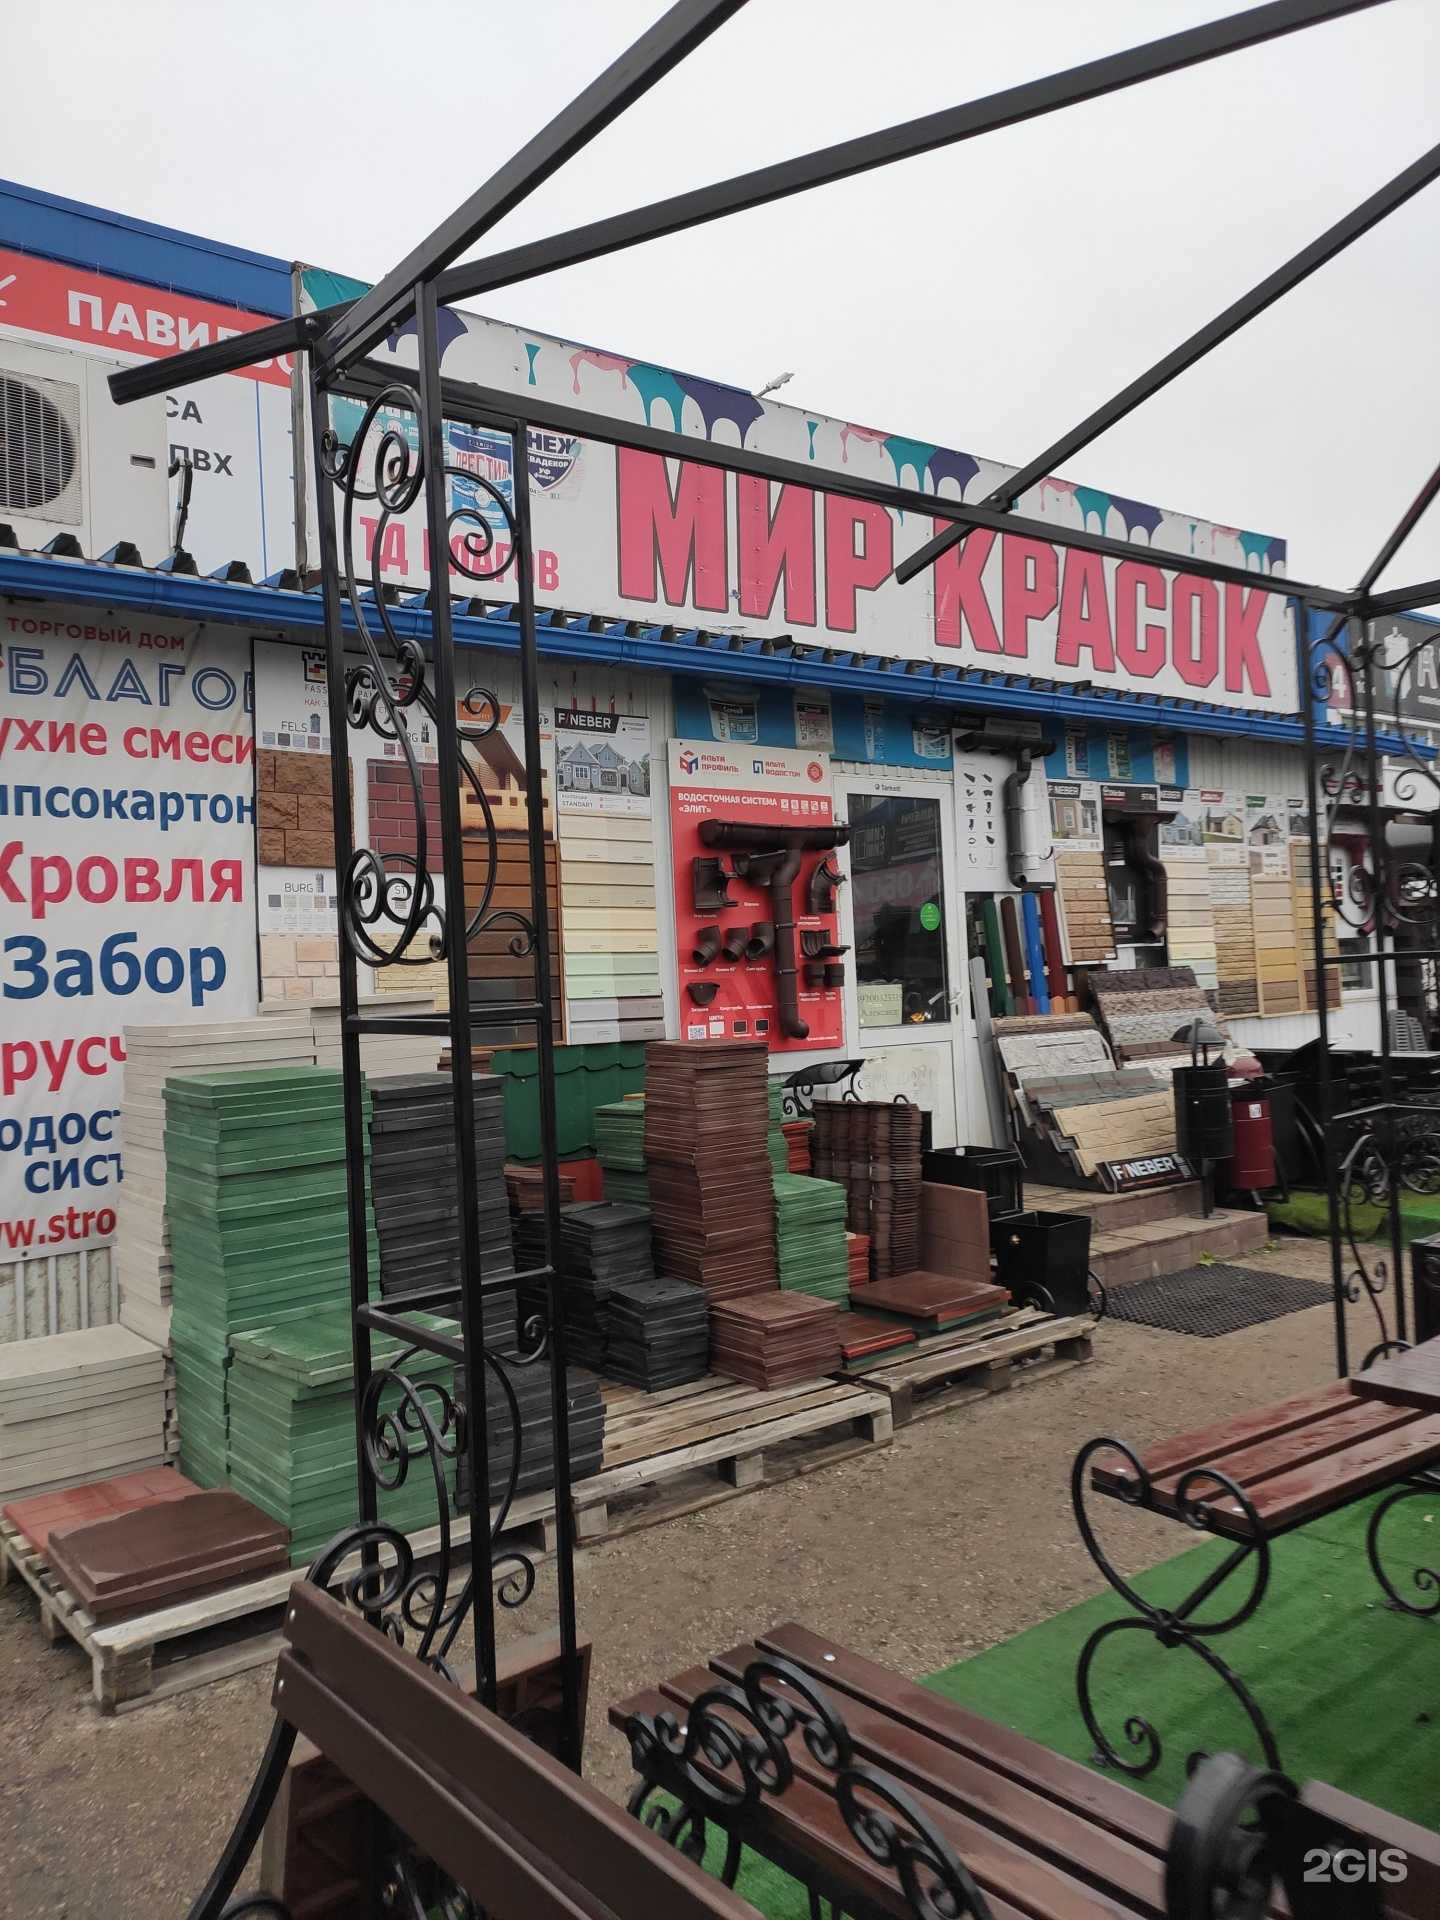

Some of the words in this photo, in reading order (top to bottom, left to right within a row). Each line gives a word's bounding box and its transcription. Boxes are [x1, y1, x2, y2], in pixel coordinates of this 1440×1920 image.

[67, 289, 295, 376] ПАВИ
[527, 454, 570, 468] ВАДЕКОР
[359, 516, 408, 576] ТД
[422, 528, 559, 591] ЛАГВ
[615, 444, 894, 634] МИР
[932, 516, 1272, 698] КРАСОК
[7, 616, 131, 645] ТОРГОВЫЙ
[138, 632, 185, 650] ДОМ
[123, 726, 254, 765] смеси
[281, 721, 308, 733] FELS
[701, 763, 740, 774] ПРОФИЛЬ
[678, 792, 741, 804] ВОДОСТОЧНАЯ
[742, 796, 778, 807] СИСТЕМА
[0, 841, 243, 919] Кровля
[284, 882, 314, 893] BURG
[3, 931, 227, 1007] Забор
[0, 1109, 121, 1156] одос
[0, 1206, 117, 1248] w.stro
